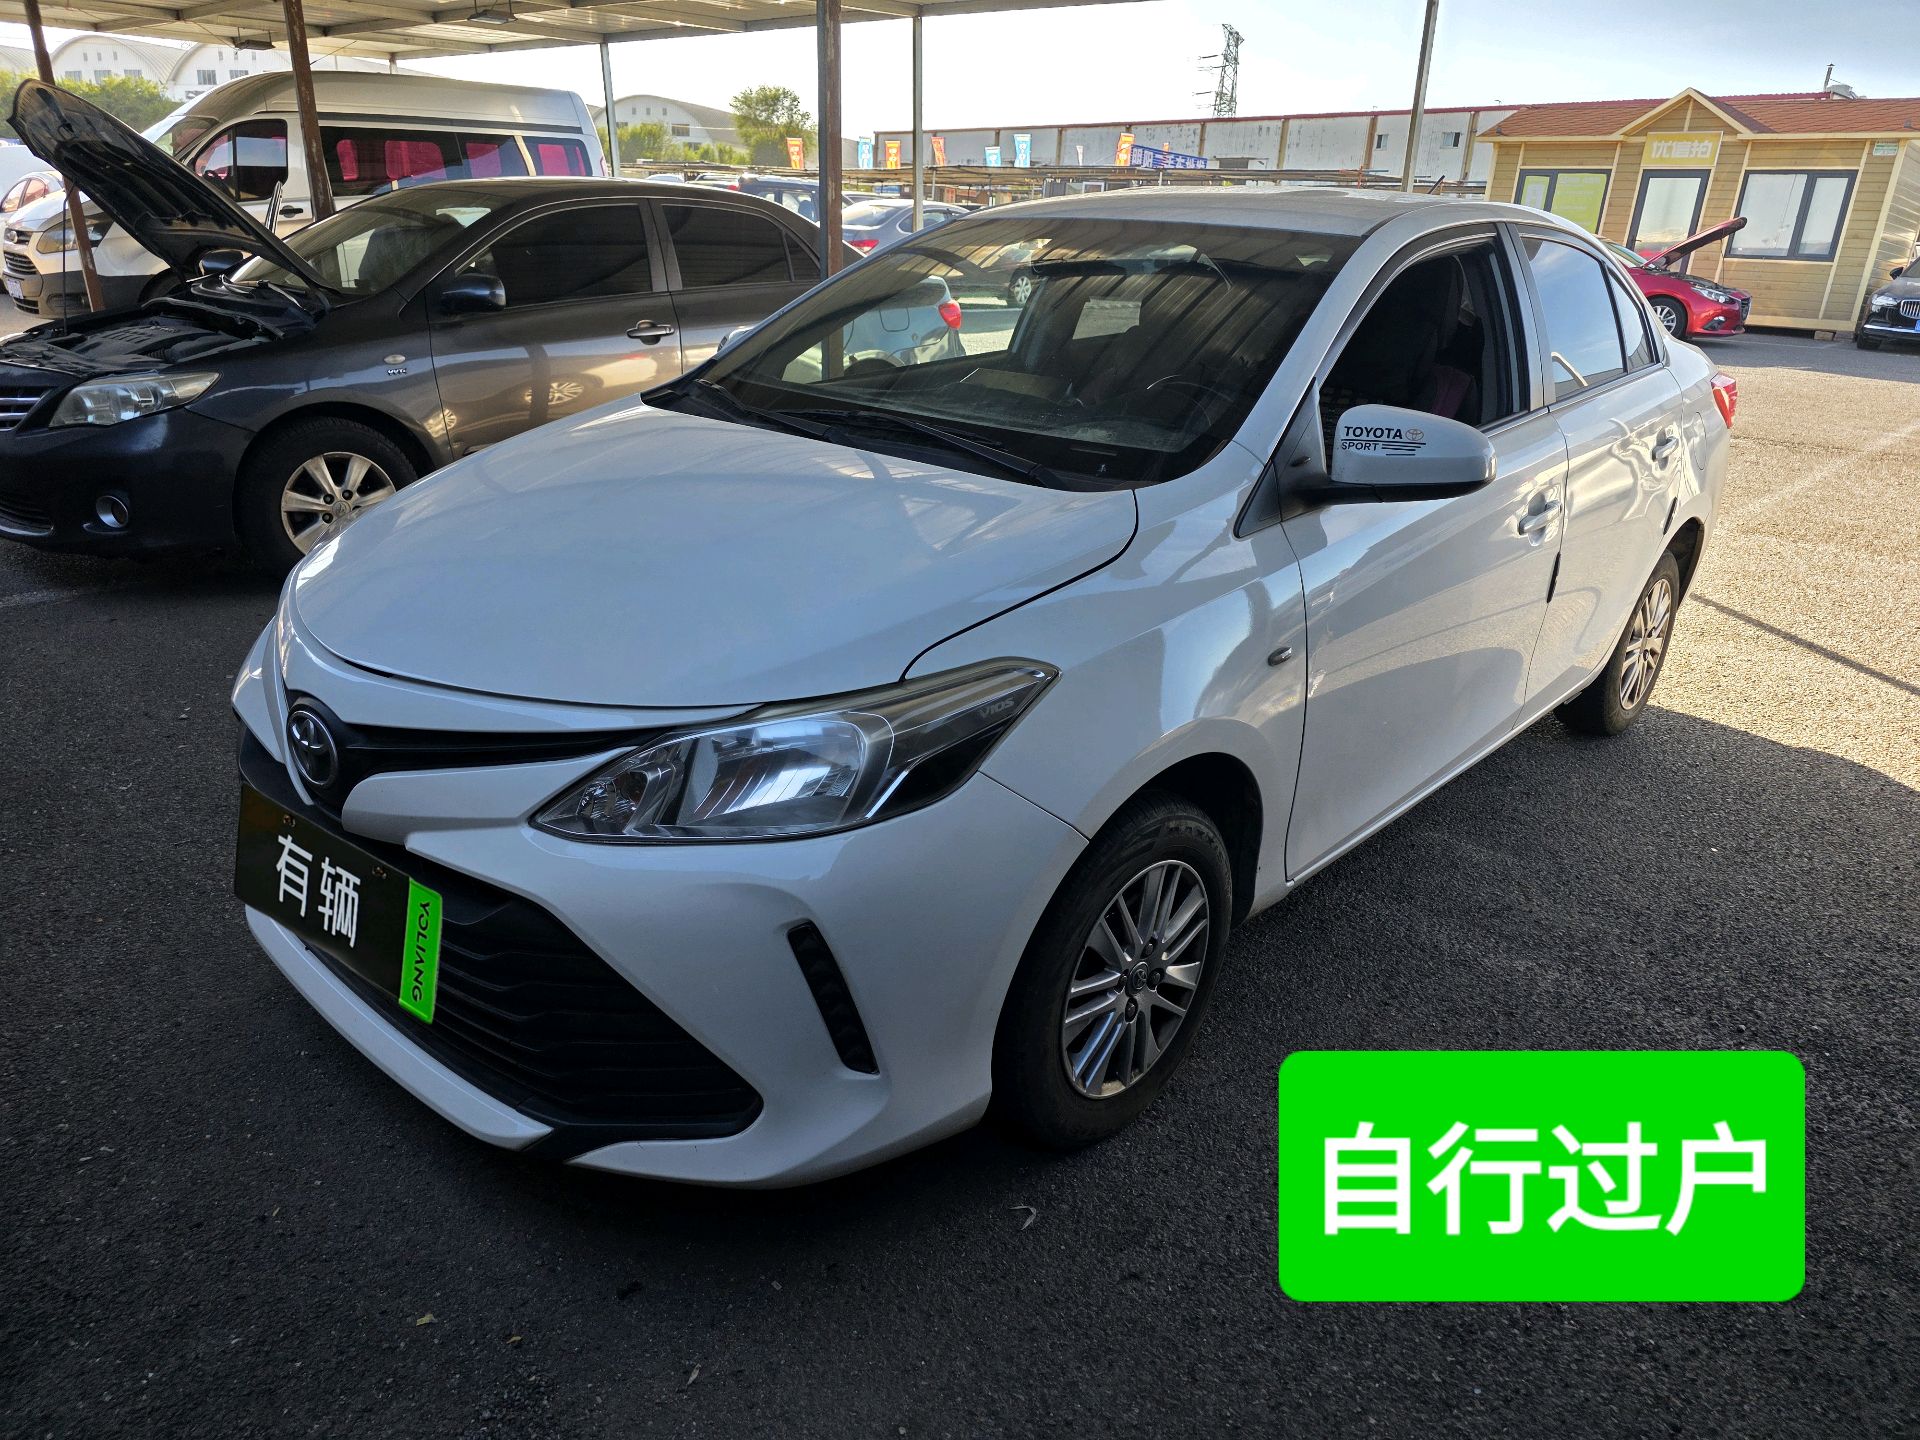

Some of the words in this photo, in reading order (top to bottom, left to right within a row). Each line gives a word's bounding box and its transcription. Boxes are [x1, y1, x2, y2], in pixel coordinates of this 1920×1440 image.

[1341, 441, 1379, 451] SPORT
[1344, 426, 1403, 440] TOYOTA
[276, 834, 361, 949] 有辆
[412, 902, 430, 1002] YOLIANG
